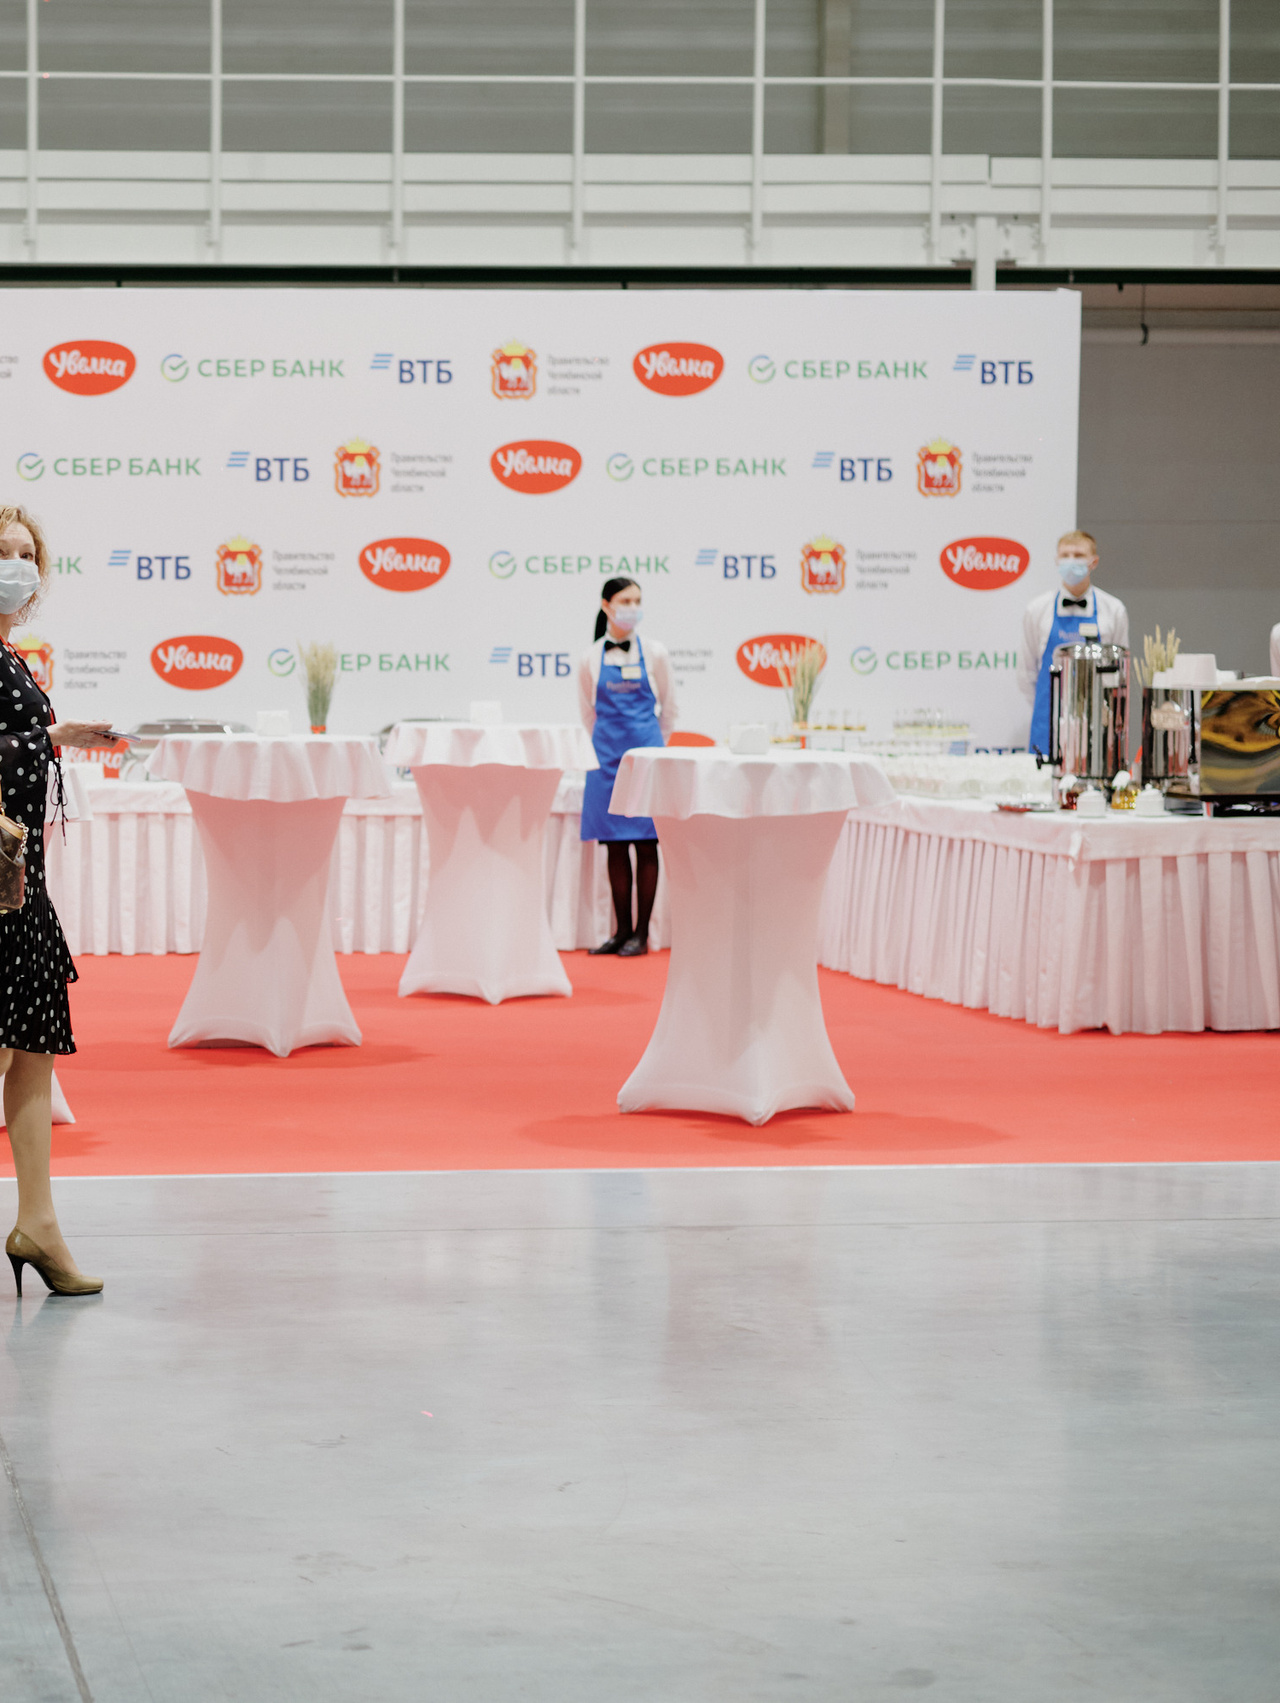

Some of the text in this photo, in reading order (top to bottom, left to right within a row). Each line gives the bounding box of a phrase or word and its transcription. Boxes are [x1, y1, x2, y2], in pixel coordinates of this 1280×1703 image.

[399, 360, 453, 384] ВТБ
[981, 361, 1034, 385] ВТБ
[256, 458, 309, 482] ВТБ
[840, 458, 893, 482] ВТБ
[137, 556, 191, 580] ВТБ
[723, 555, 776, 579] ВТБ
[518, 653, 571, 677] ВТБ
